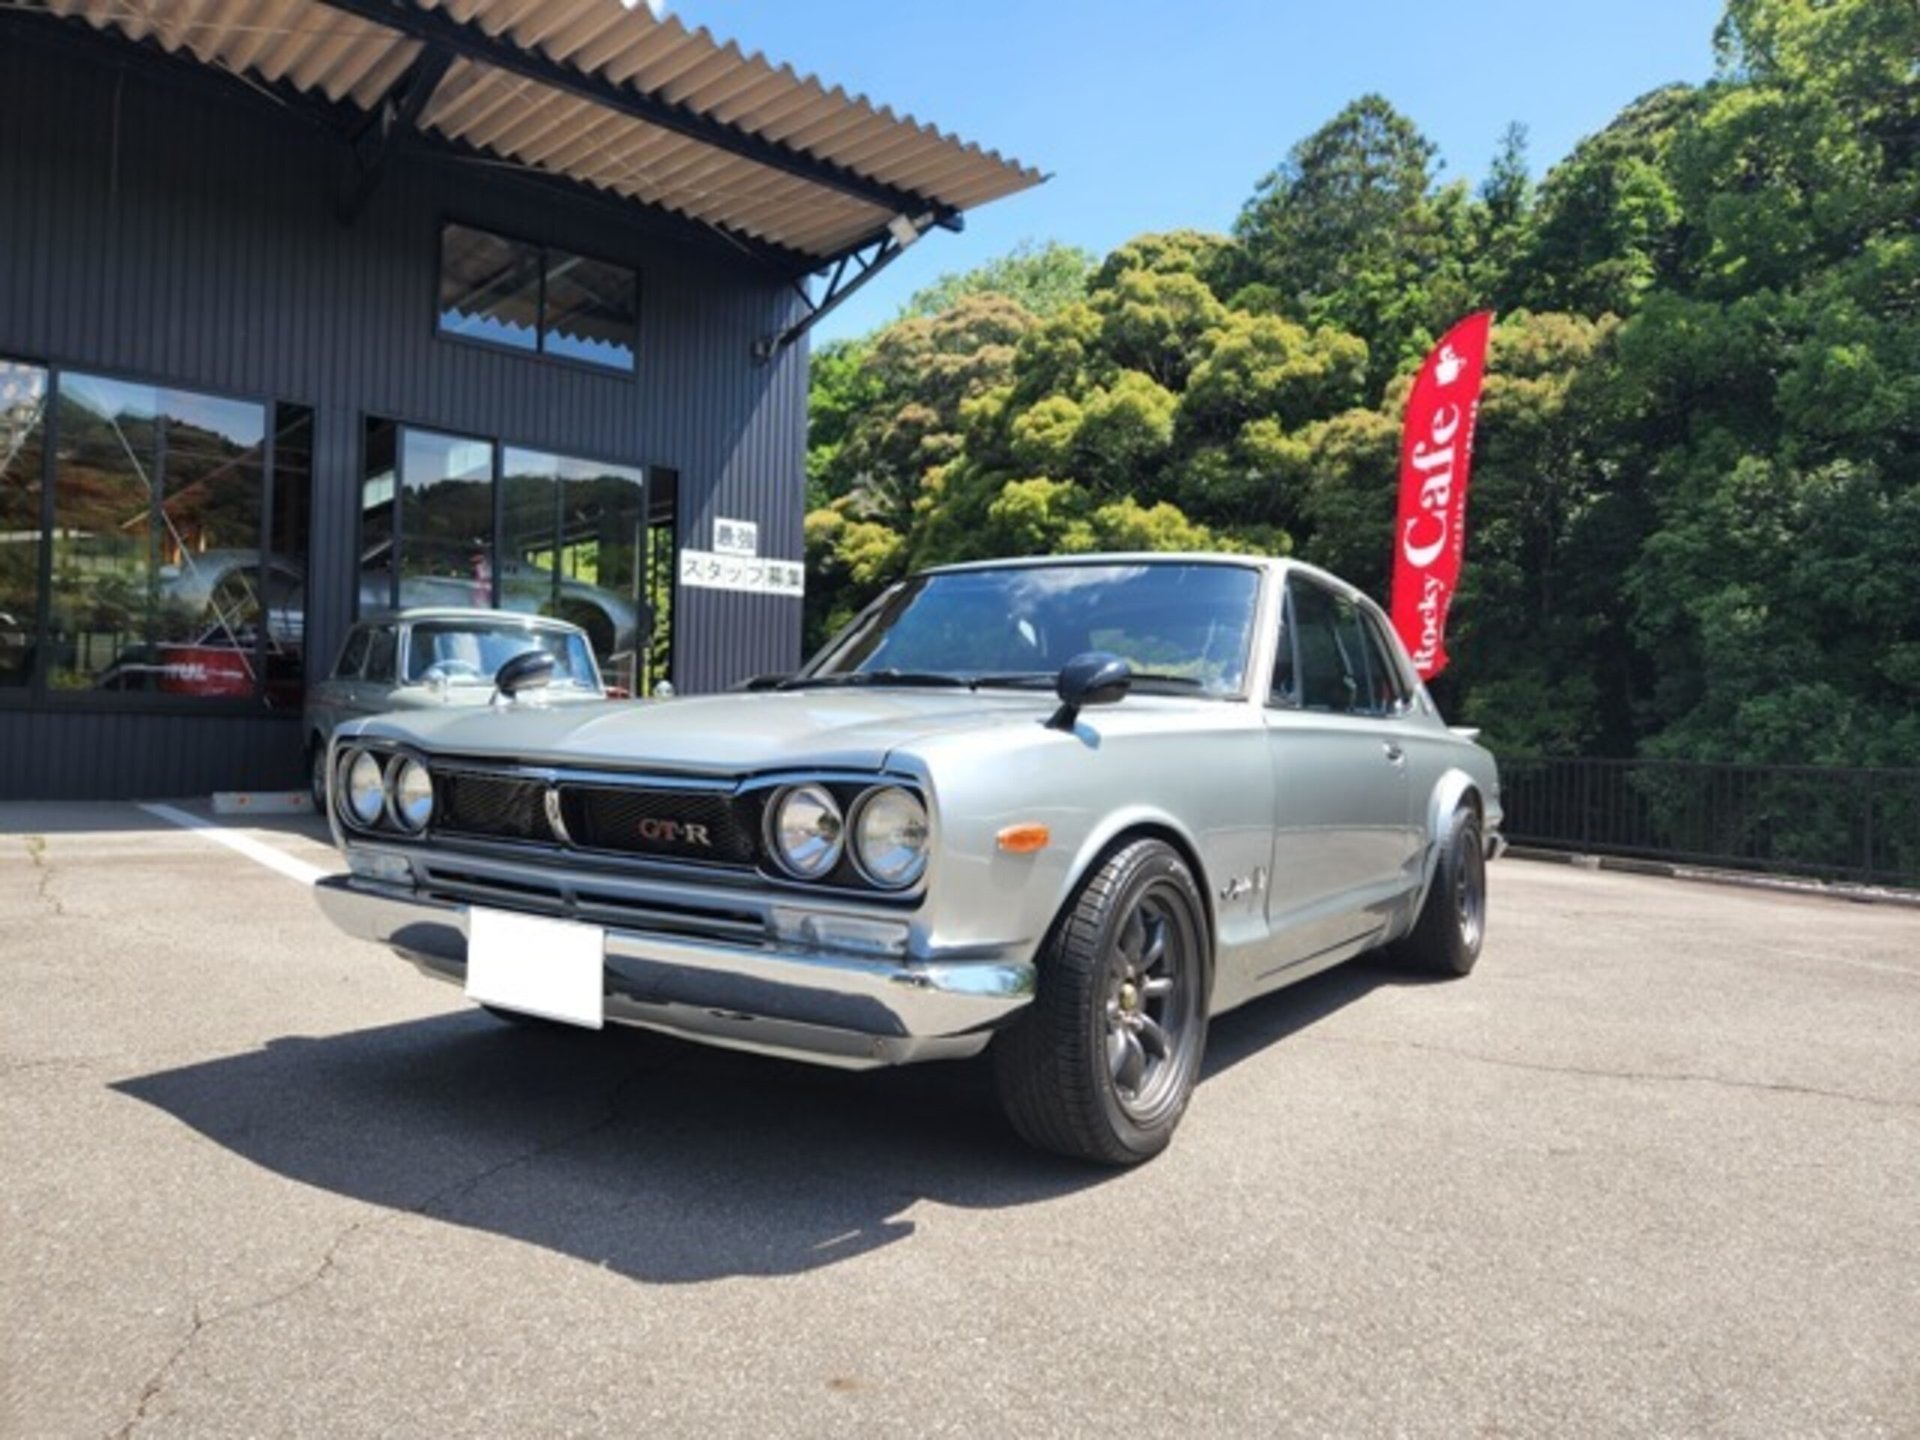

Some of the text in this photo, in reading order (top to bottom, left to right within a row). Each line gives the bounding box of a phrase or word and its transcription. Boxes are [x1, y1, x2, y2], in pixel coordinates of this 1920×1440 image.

[1403, 402, 1460, 670] Rocky Cafe
[640, 818, 712, 847] GT-R
